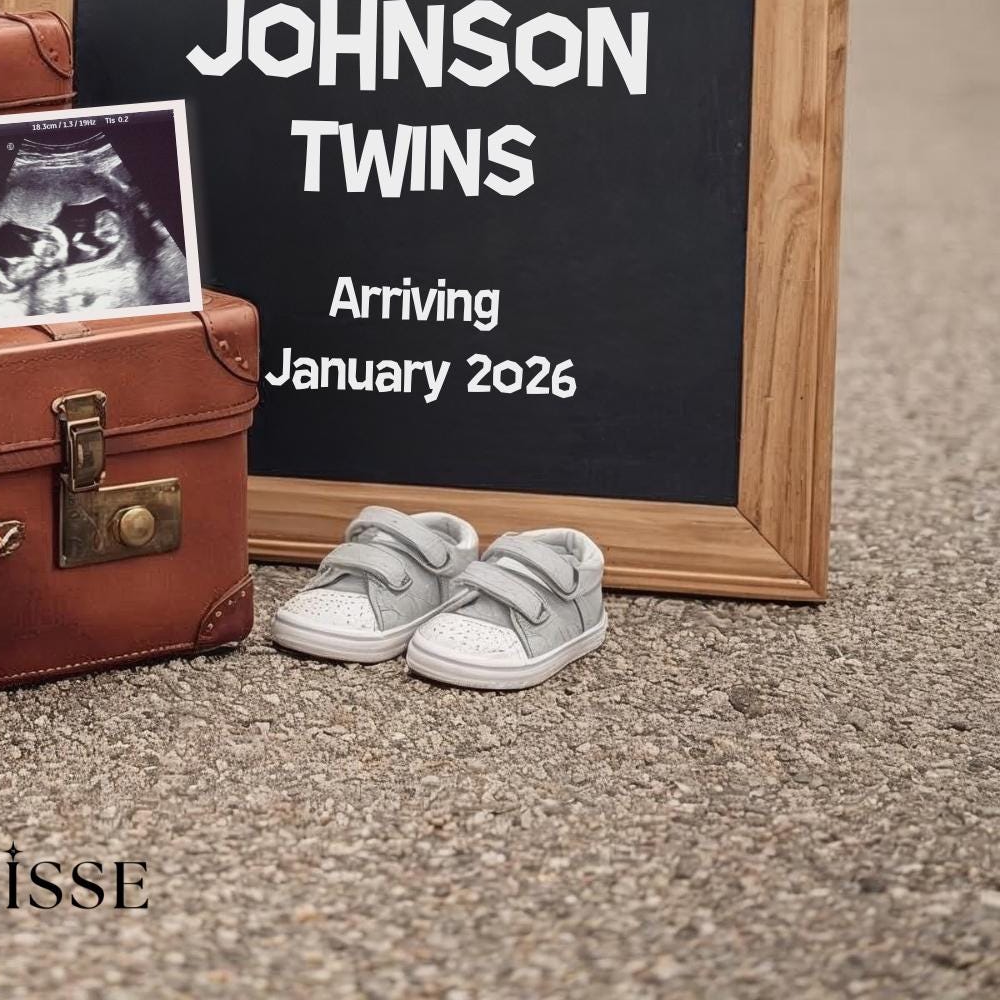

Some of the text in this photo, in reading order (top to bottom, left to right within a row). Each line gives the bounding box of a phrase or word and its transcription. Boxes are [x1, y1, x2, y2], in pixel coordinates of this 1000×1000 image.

[32, 122, 58, 131] 18.3cm
[79, 119, 96, 127] 19Hz
[291, 120, 536, 197] TWINS
[329, 277, 499, 331] Arriving
[265, 348, 576, 403] January 2026
